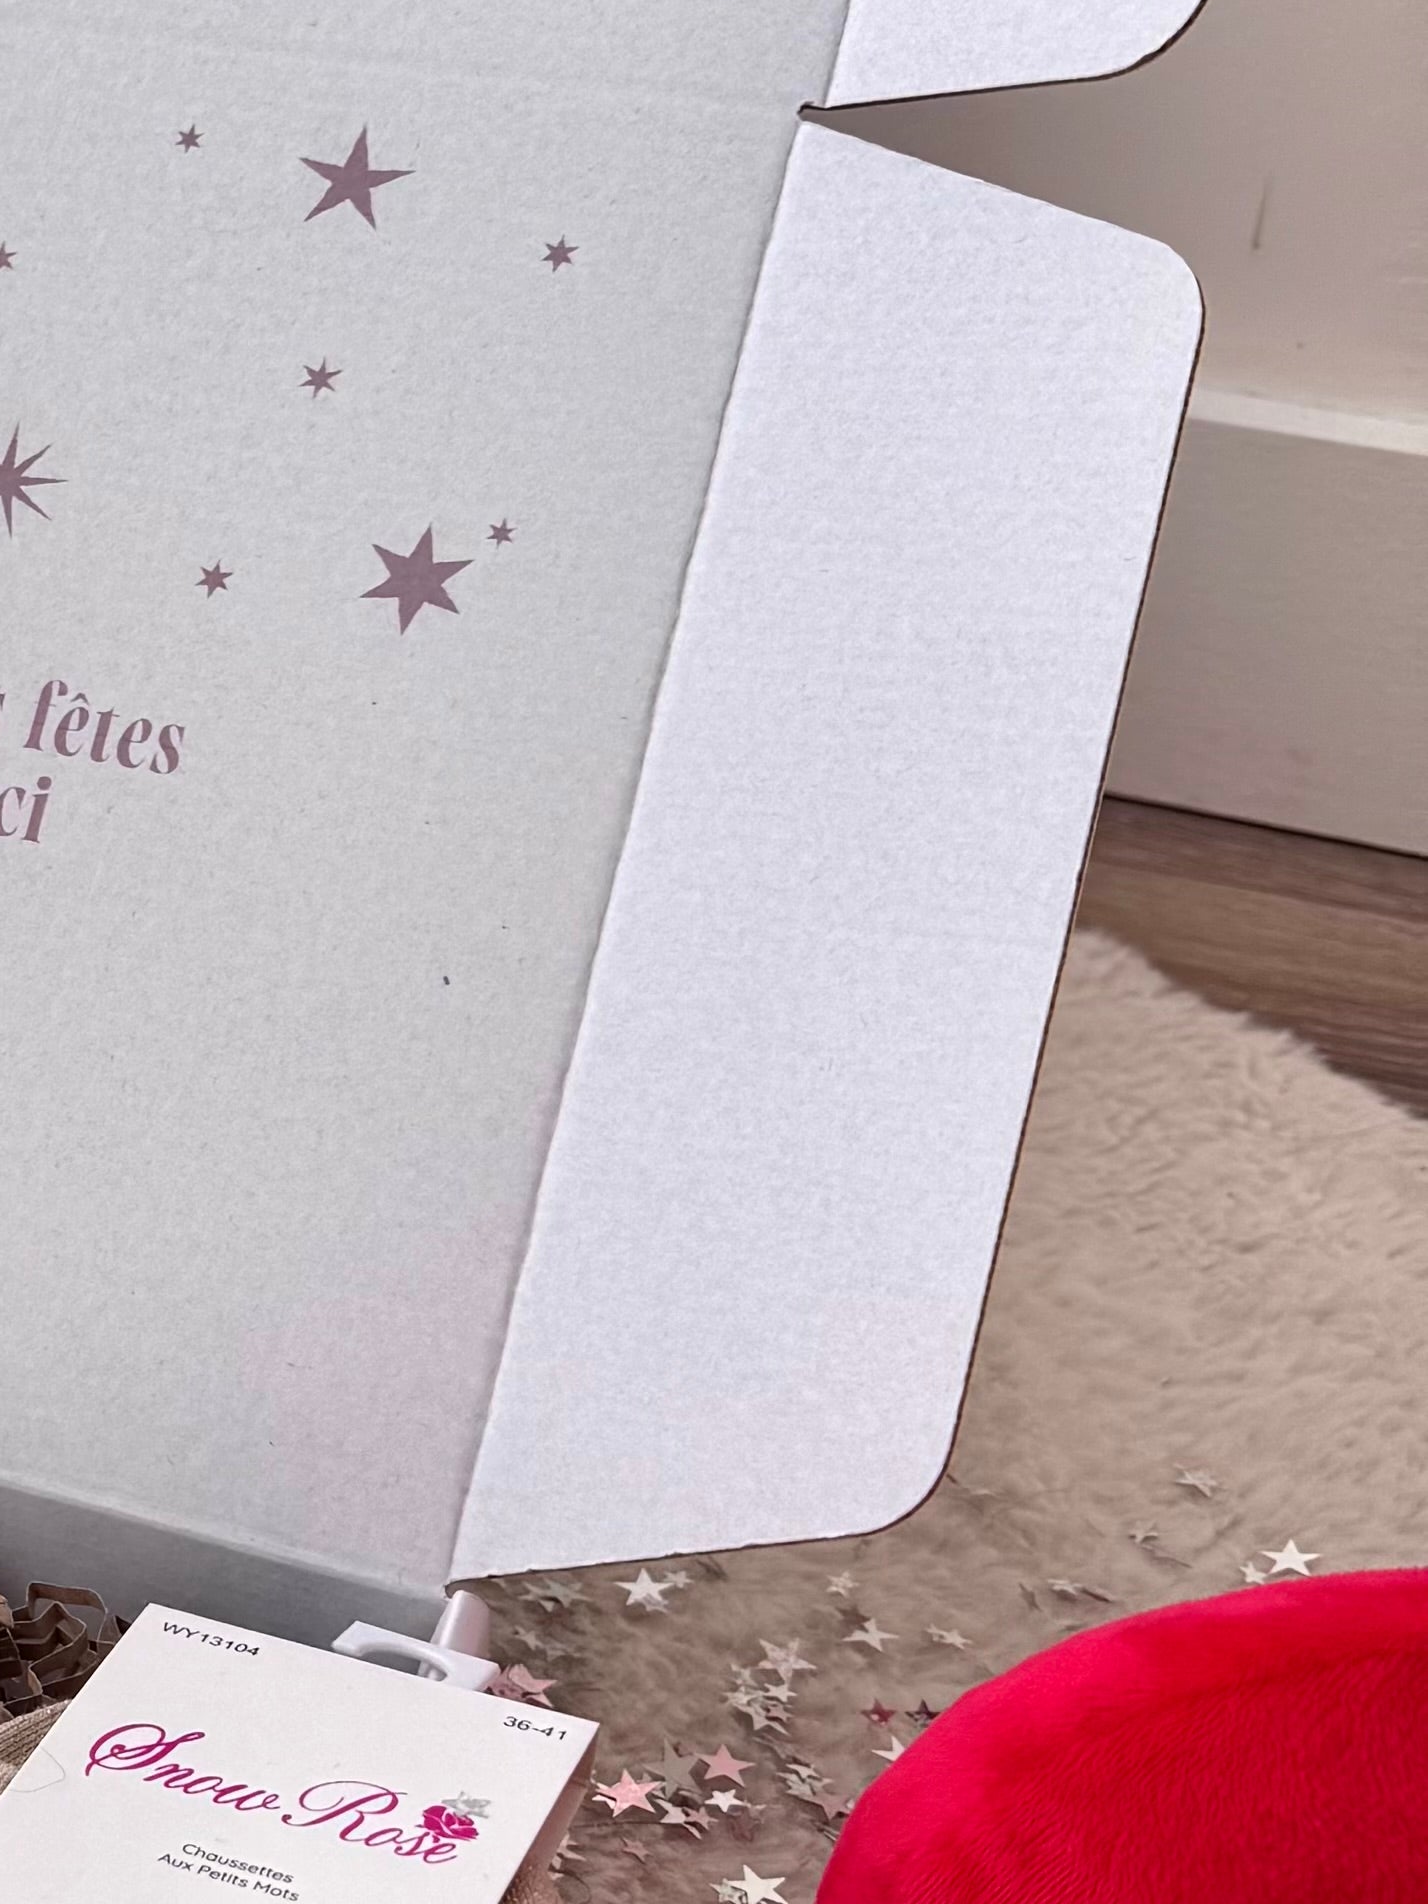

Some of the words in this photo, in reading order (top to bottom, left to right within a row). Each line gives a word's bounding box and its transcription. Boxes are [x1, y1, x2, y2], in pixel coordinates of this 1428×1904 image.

[23, 679, 186, 775] fêtes
[163, 1621, 261, 1657] WY13104
[503, 1715, 567, 1741] 36-41
[84, 1723, 282, 1812] Snow
[281, 1780, 458, 1865] Rose
[157, 1853, 195, 1872] Aux
[196, 1864, 249, 1888] Petits
[252, 1880, 300, 1902] Mots
[182, 1843, 295, 1884] Chaussettes
